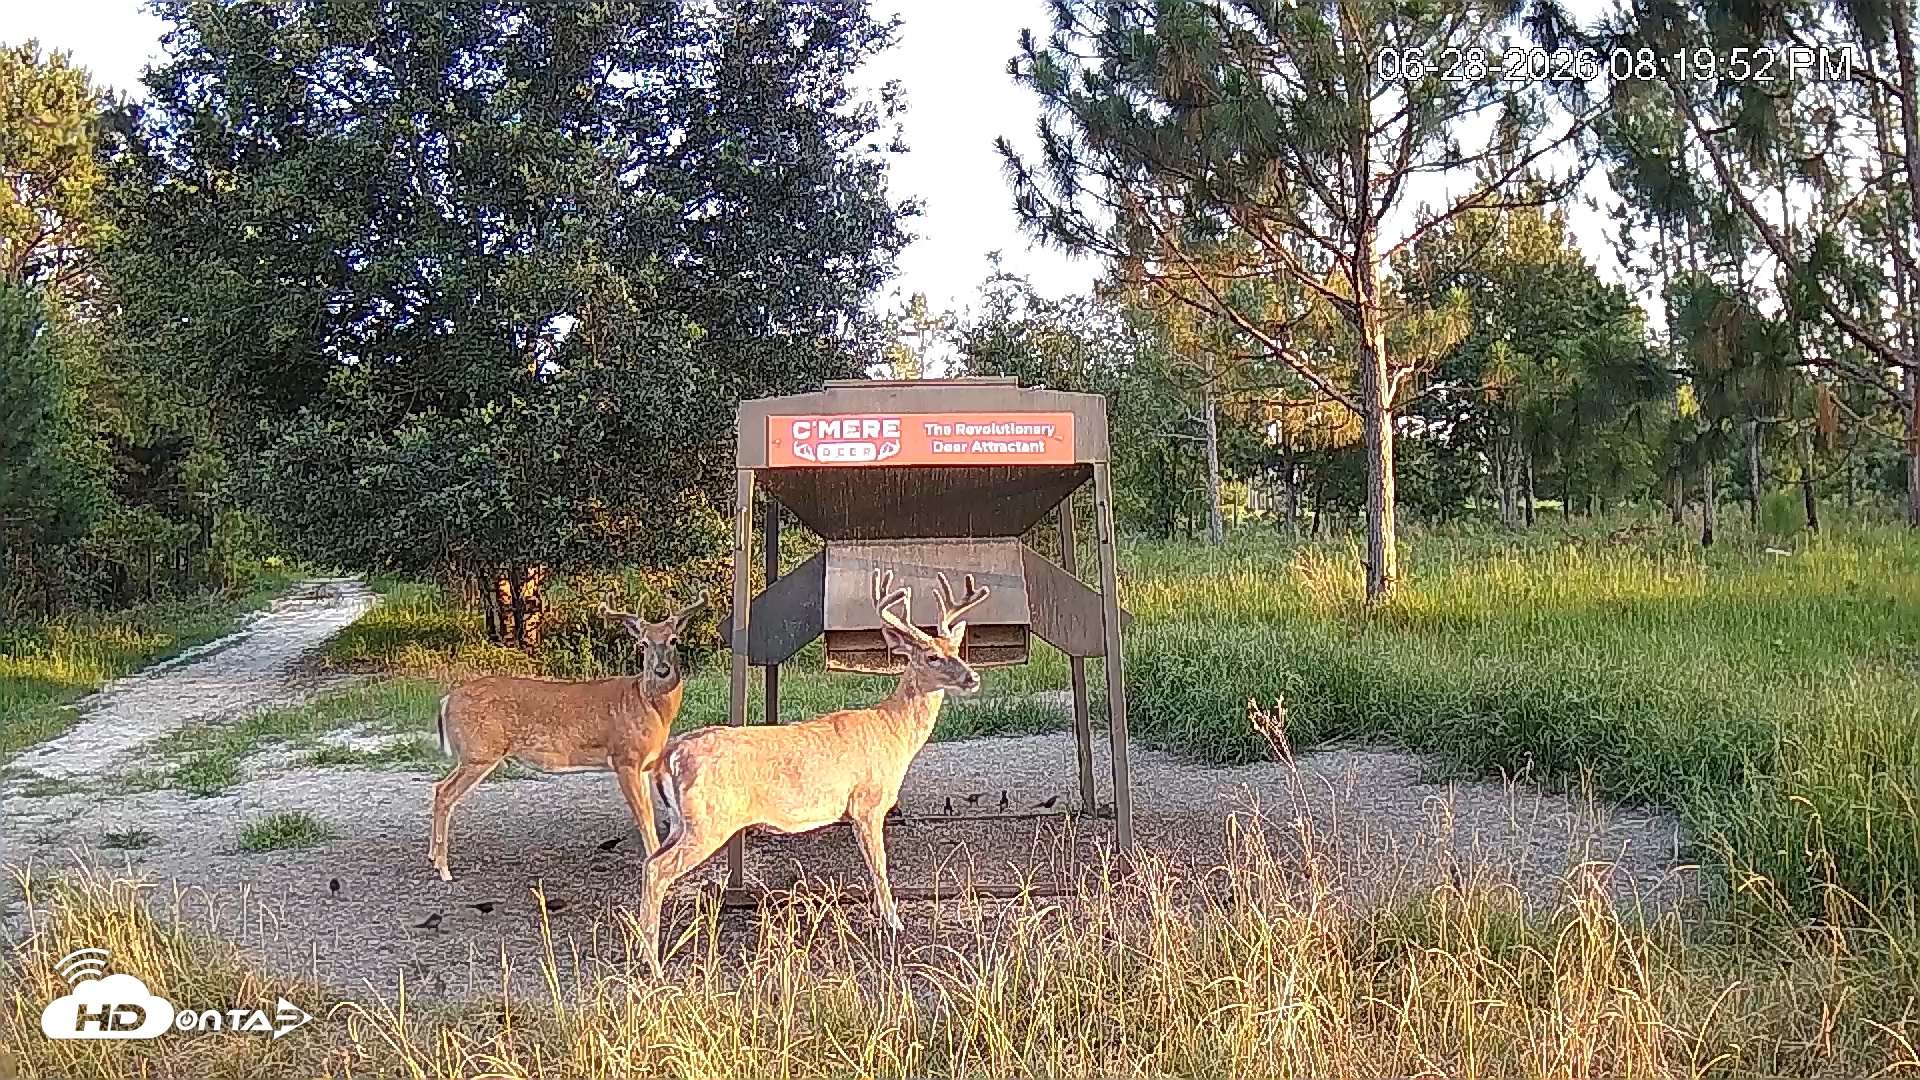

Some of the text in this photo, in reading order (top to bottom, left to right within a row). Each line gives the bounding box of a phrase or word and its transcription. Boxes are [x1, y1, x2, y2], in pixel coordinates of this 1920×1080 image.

[792, 419, 901, 440] C'MERE
[924, 422, 1056, 437] The Revolutionary
[822, 447, 871, 457] DEER
[933, 440, 1046, 453] Deer Attractant
